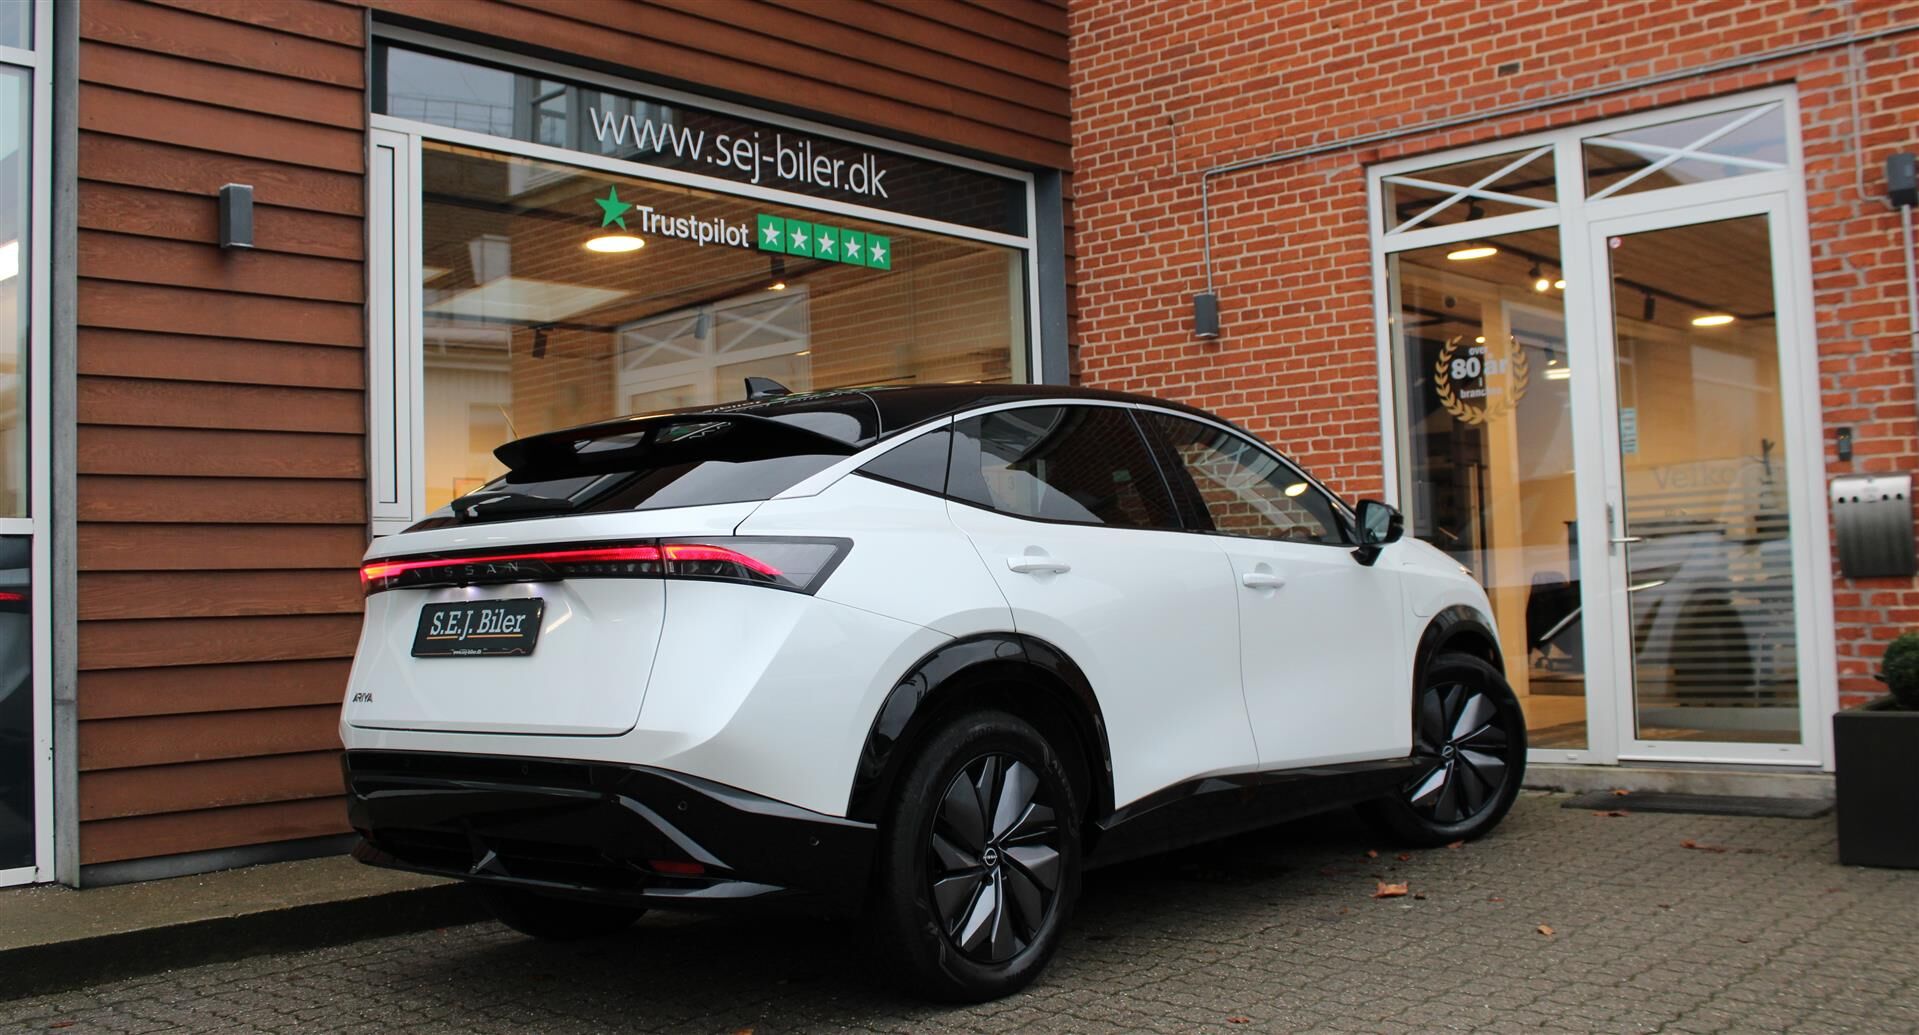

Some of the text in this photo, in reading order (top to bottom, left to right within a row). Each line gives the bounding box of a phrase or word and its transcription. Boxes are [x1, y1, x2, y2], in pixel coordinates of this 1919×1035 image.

[589, 106, 889, 199] www.sej-biler.dk
[635, 204, 750, 248] Trustpilot
[1451, 357, 1481, 379] 80
[1460, 386, 1504, 399] branc
[429, 608, 526, 641] S.E.J. Biler
[352, 692, 373, 703] ARIYA
